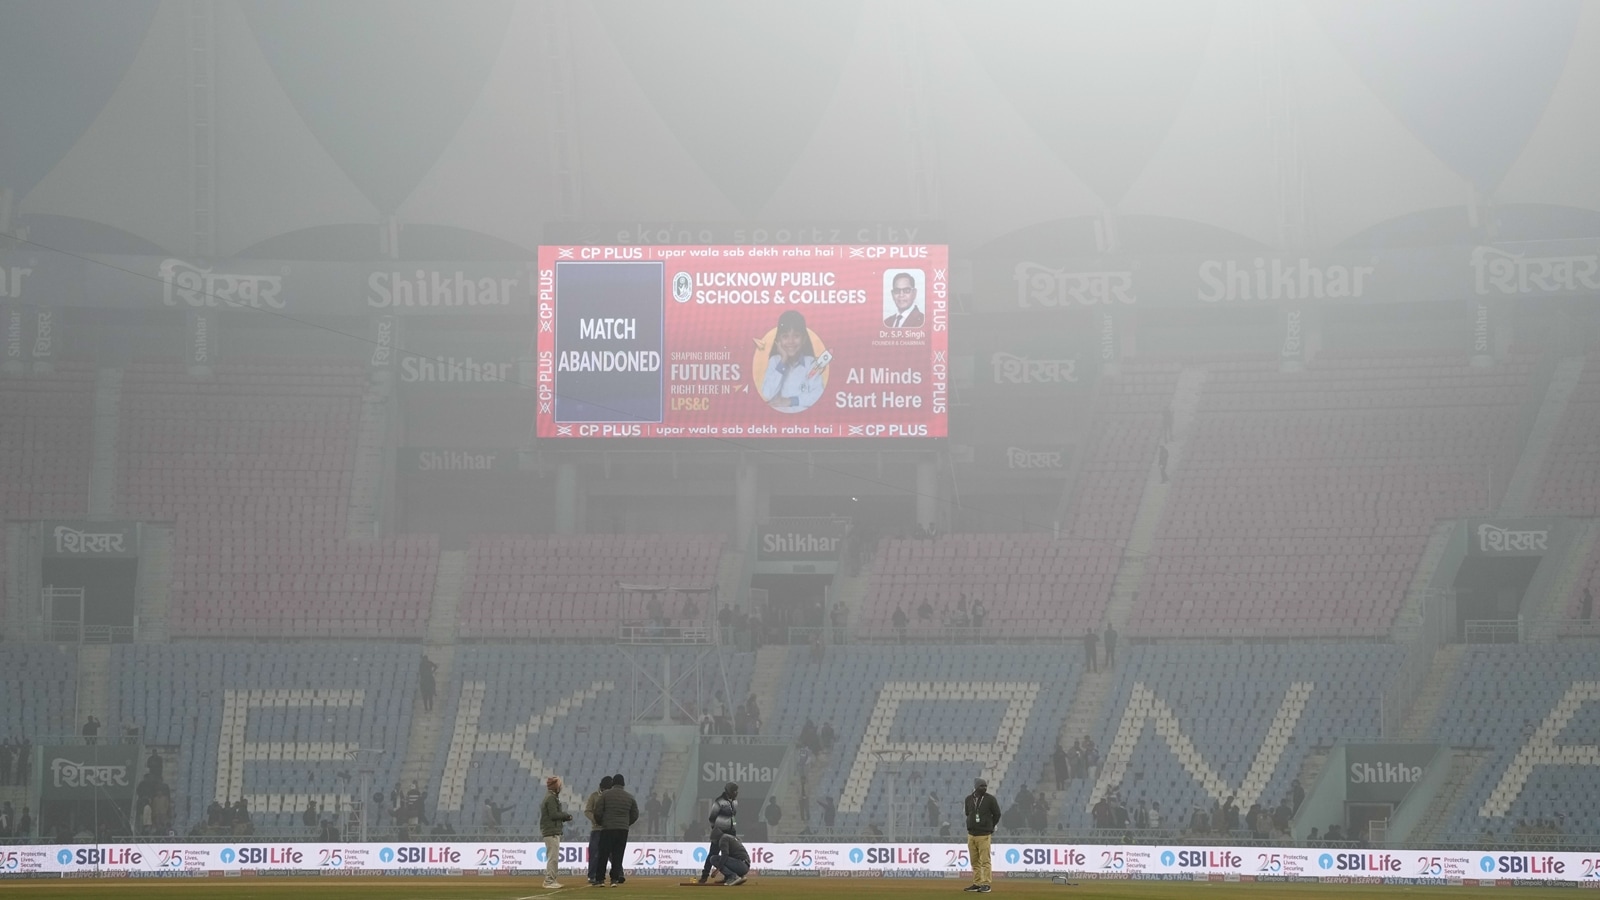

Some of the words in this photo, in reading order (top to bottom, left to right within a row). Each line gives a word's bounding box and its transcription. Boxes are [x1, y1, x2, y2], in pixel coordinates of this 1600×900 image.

[617, 224, 713, 244] ekana
[733, 227, 841, 245] sportz
[857, 225, 919, 245] city
[581, 247, 601, 259] CP
[604, 247, 643, 259] PLUS
[657, 248, 687, 259] upar
[690, 247, 720, 257] wala
[723, 247, 745, 257] sab
[748, 247, 779, 257] dekh
[783, 247, 811, 257] raha
[815, 247, 834, 257] hai
[866, 247, 887, 259] CP
[890, 247, 928, 259] PLUS
[1470, 245, 1600, 295] शिखर
[158, 259, 286, 309] शिखर
[367, 270, 518, 307] Shikhar
[540, 269, 553, 300] PLUS
[696, 272, 777, 287] LUCKNOW
[780, 272, 836, 287] PUBLIC
[1013, 262, 1136, 308] शिखर
[1198, 258, 1375, 302] Shikhar
[696, 290, 770, 304] SCHOOLS
[773, 290, 786, 304] &
[789, 290, 867, 304] COLLEGES
[933, 282, 946, 299] CP
[540, 302, 553, 319] CP
[933, 301, 946, 332] PLUS
[8, 310, 21, 358] Shikhar
[32, 311, 52, 357] शिखर
[580, 318, 636, 340] MATCH
[879, 330, 891, 339] Dr.
[905, 330, 926, 340] Singh
[1102, 311, 1114, 360] Shikhar
[1282, 311, 1301, 357] शिखर
[1474, 304, 1488, 351] Shikhar
[195, 316, 208, 362] Shikhar
[371, 321, 392, 366] शिखर
[558, 350, 660, 372] ABANDONED
[671, 351, 703, 361] SHAPING
[704, 351, 731, 361] BRIGHT
[401, 356, 512, 382] Shikhar
[540, 351, 553, 382] PLUS
[671, 364, 741, 381] FUTURES
[846, 367, 865, 384] AI
[870, 367, 922, 384] Minds
[933, 364, 946, 380] CP
[991, 352, 1079, 384] शिखर
[539, 384, 552, 400] CP
[671, 384, 696, 395] RIGHT
[698, 384, 720, 395] HERE
[721, 384, 731, 395] IN
[933, 382, 946, 414] PLUS
[671, 397, 710, 411] LPS&C
[835, 391, 877, 409] Start
[882, 391, 922, 409] Here
[579, 424, 600, 436] CP
[602, 424, 641, 436] PLUS
[656, 426, 686, 437] upar
[688, 425, 718, 434] wala
[722, 425, 744, 434] sab
[747, 425, 778, 434] dekh
[781, 425, 810, 434] raha
[814, 425, 833, 434] hai
[865, 424, 886, 436] CP
[889, 424, 928, 436] PLUS
[418, 451, 496, 470] Shikhar
[1006, 446, 1062, 469] शिखर
[54, 526, 126, 553] शिखर
[763, 533, 841, 554] Shikhar
[1477, 524, 1549, 552] शिखर
[51, 758, 128, 789] शिखर
[1350, 761, 1423, 784] Shikha
[75, 848, 106, 865] SBI
[109, 848, 142, 865] Life
[158, 850, 182, 867] 25
[238, 847, 268, 864] SBI
[271, 847, 303, 864] Life
[319, 849, 342, 866] 25
[396, 846, 426, 863] SBI
[429, 846, 461, 863] Life
[476, 849, 500, 866] 25
[632, 848, 656, 865] 25
[752, 847, 774, 864] ife
[789, 849, 813, 867] 25
[866, 847, 895, 864] SBI
[898, 847, 930, 864] Life
[945, 850, 969, 867] 25
[1022, 848, 1051, 865] SBI
[1054, 849, 1086, 866] Life
[1100, 851, 1124, 869] 25
[1178, 850, 1207, 867] SBI
[1210, 851, 1242, 868] Life
[1257, 853, 1281, 871] 25
[1336, 853, 1366, 870] SBI
[1369, 854, 1402, 871] Life
[1417, 857, 1442, 875] 25
[1498, 855, 1528, 873] SBI
[1531, 856, 1565, 874] Life
